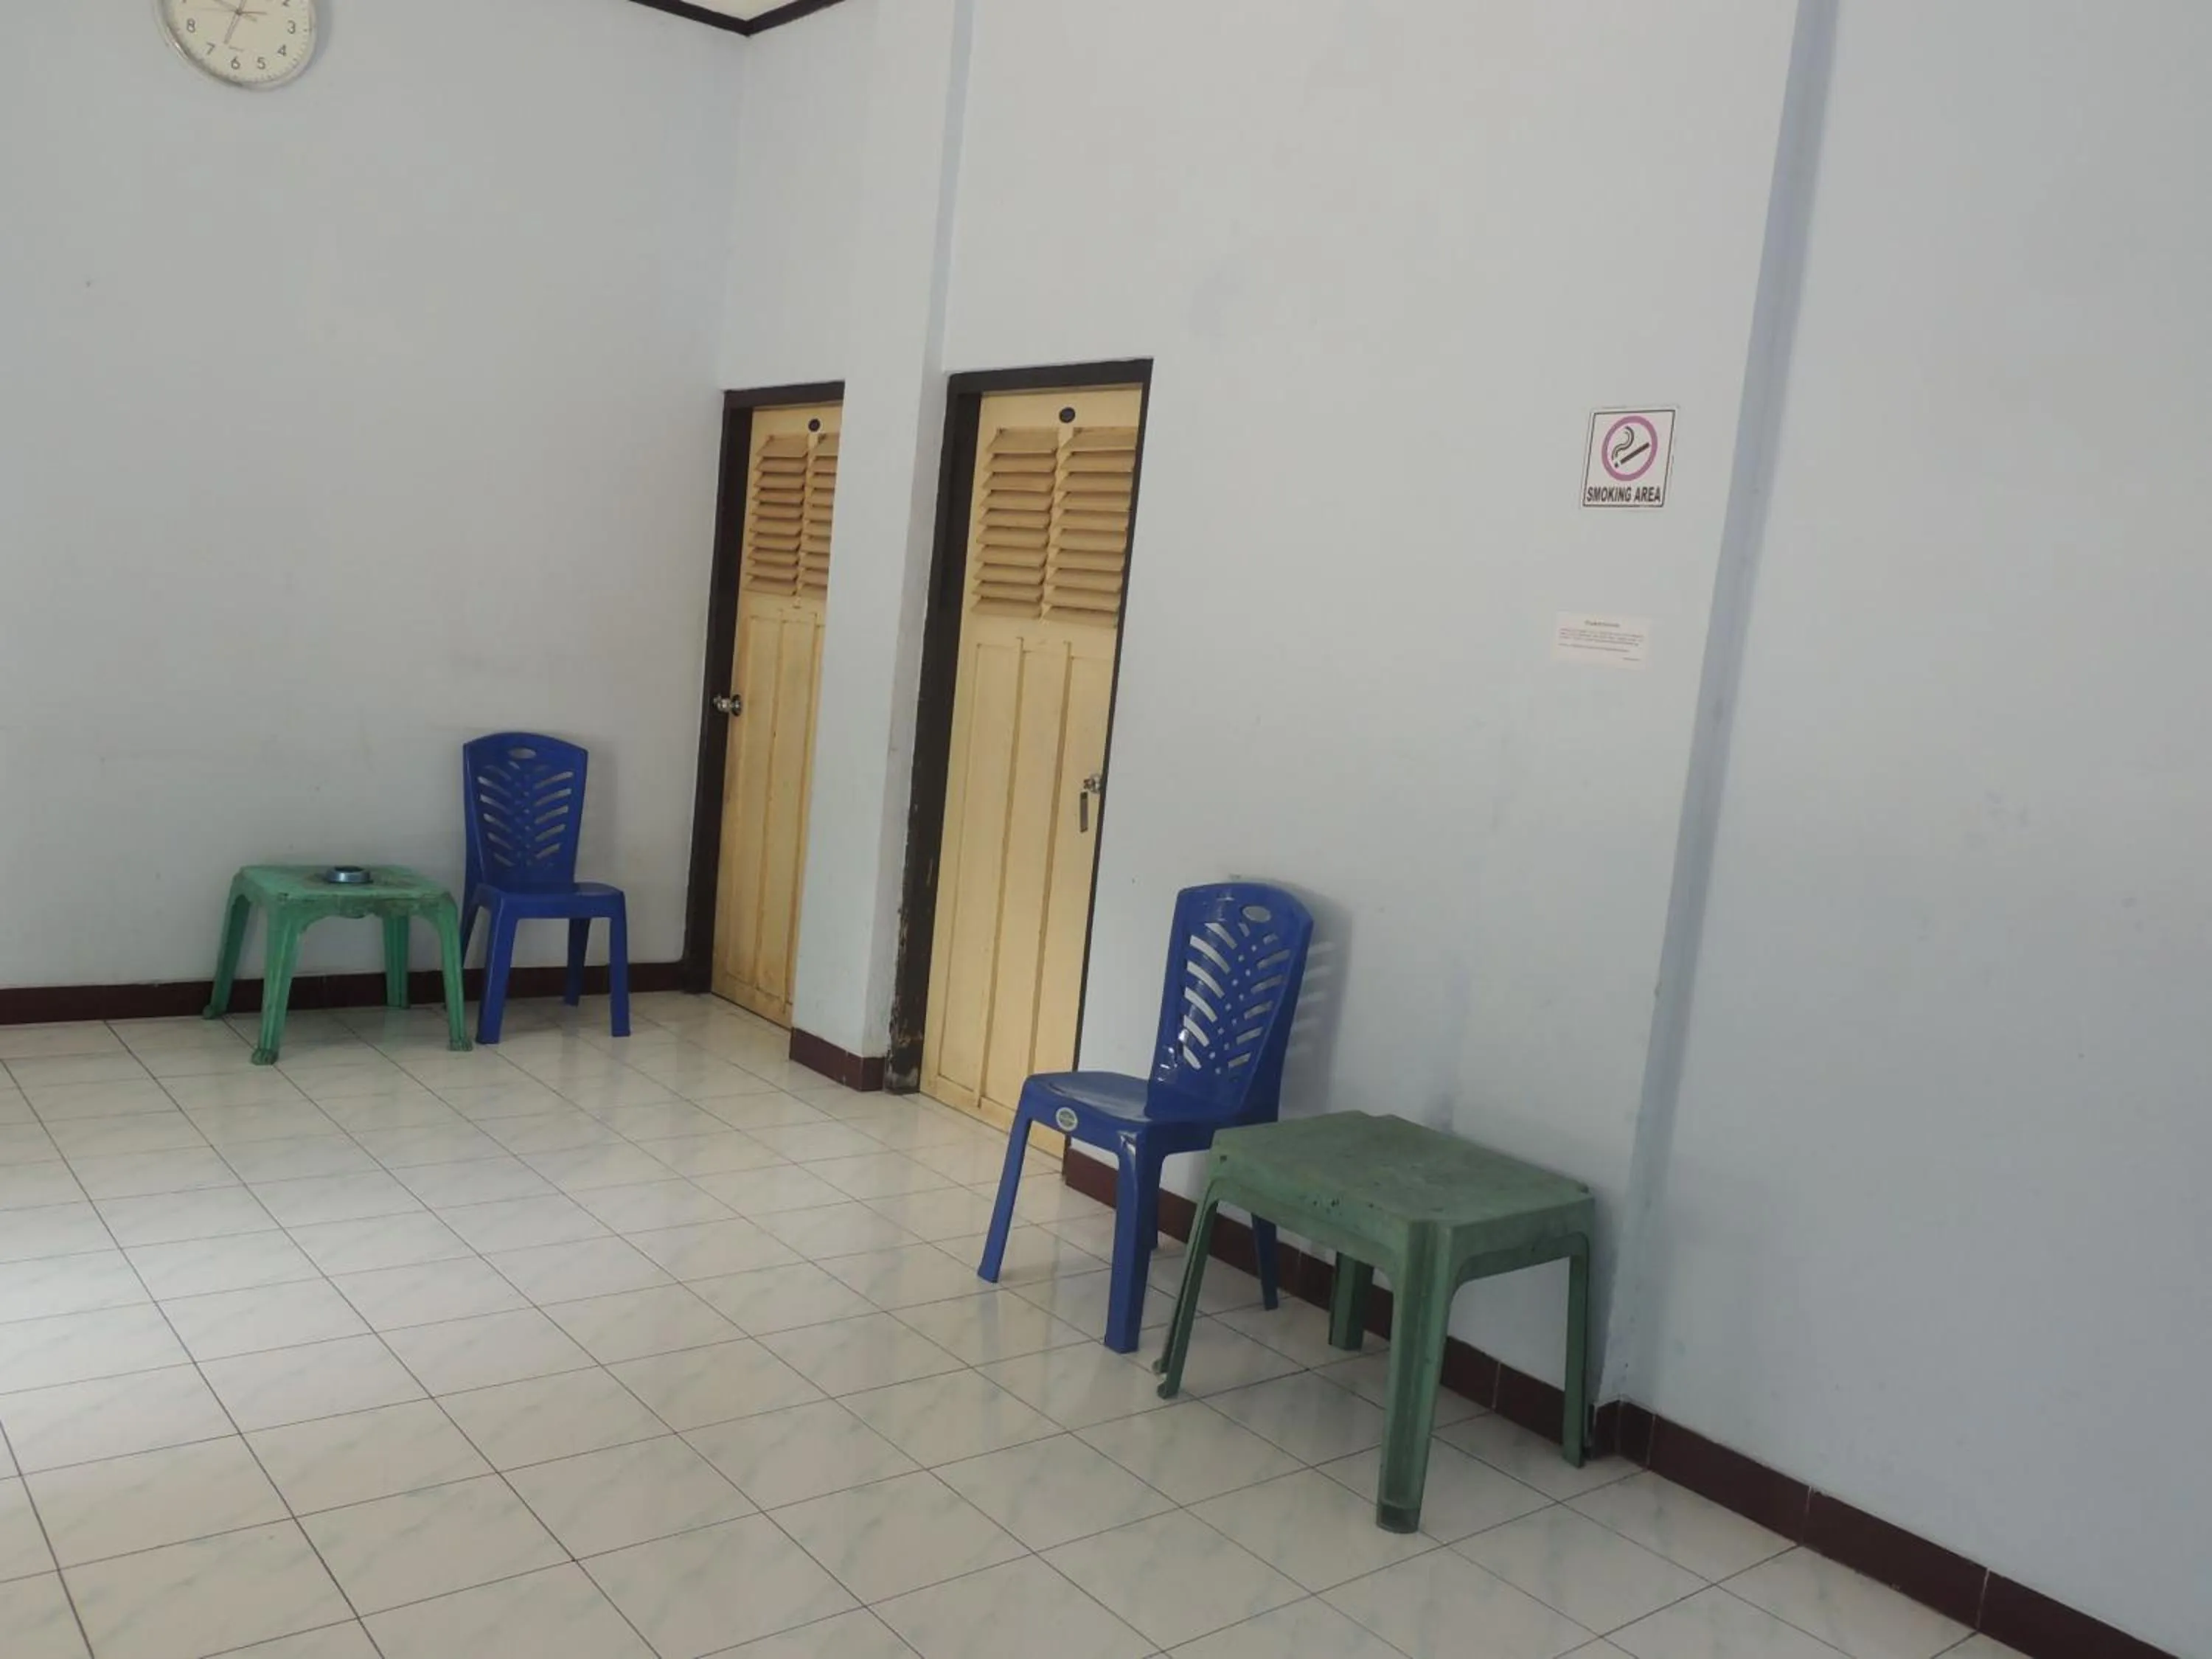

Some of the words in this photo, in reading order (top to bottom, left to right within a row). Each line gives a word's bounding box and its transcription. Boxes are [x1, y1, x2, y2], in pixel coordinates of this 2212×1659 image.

[187, 18, 195, 33] 8
[288, 20, 296, 35] 3
[206, 42, 215, 55] 7
[277, 44, 287, 57] 4
[231, 56, 240, 70] 6
[257, 57, 265, 70] 5
[1587, 486, 1632, 502] SMOKING
[1634, 486, 1660, 502] AREA
